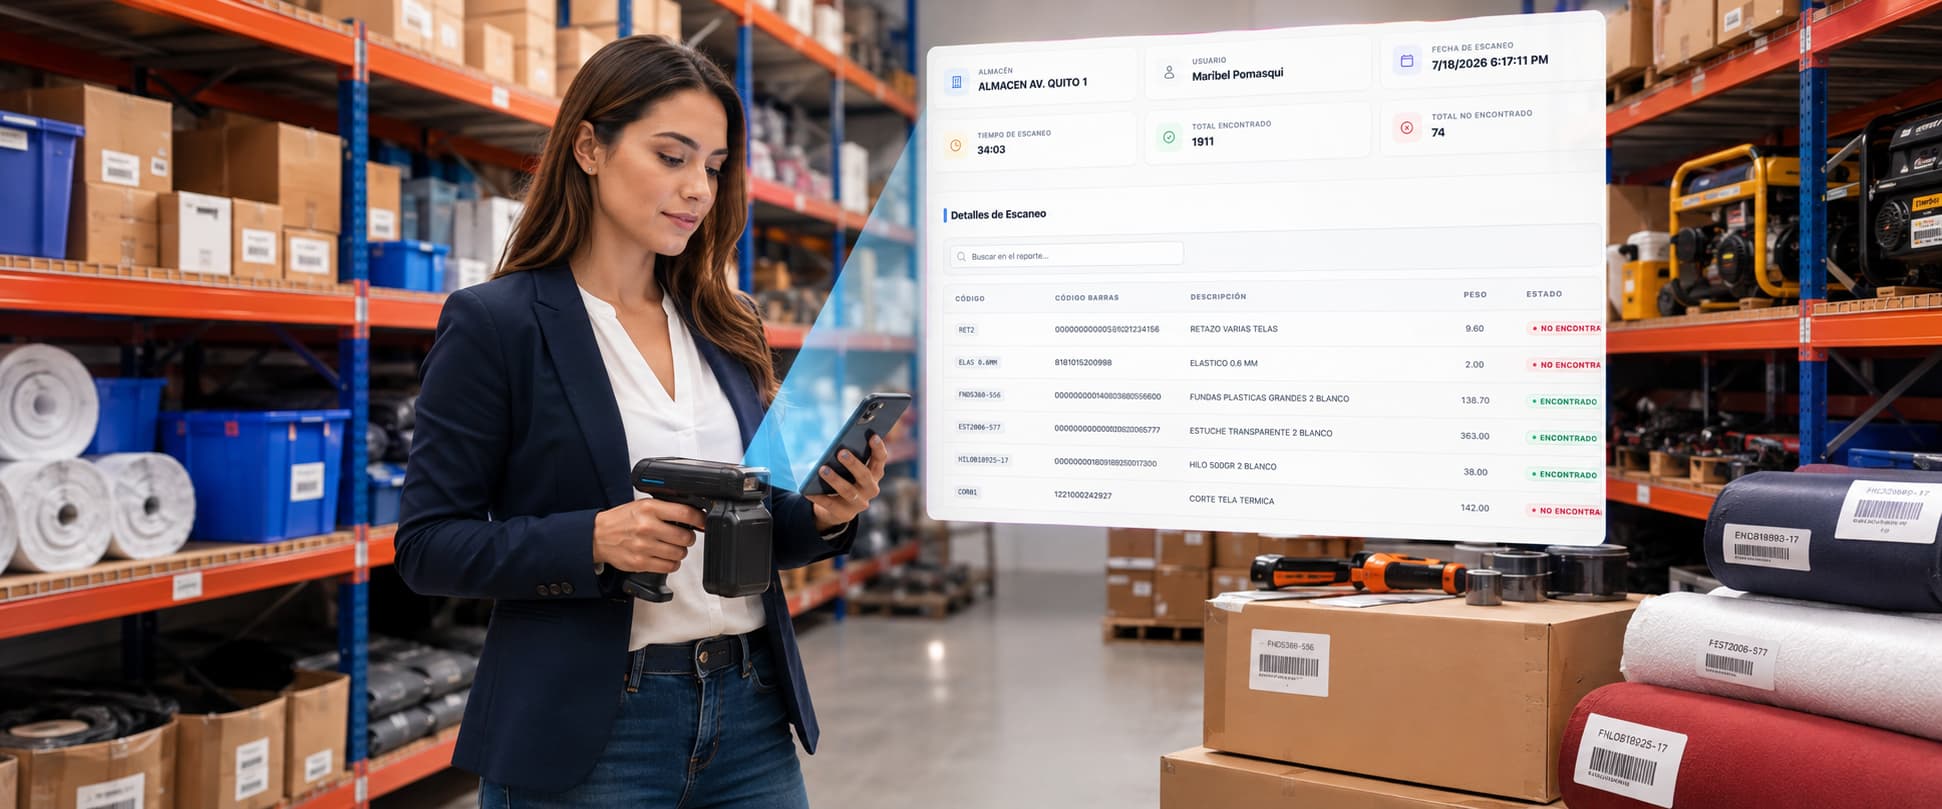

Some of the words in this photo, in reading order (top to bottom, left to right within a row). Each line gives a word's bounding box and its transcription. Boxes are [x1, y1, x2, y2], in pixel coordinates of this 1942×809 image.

[1431, 44, 1460, 54] FECHA
[1461, 43, 1473, 52] DE
[1474, 41, 1514, 51] ESCANEO
[1191, 56, 1227, 65] USUARIO
[1431, 57, 1488, 72] 7/18/2026
[1490, 55, 1528, 68] 6:17:11
[1530, 54, 1549, 65] PM
[978, 66, 1014, 76] ALMACÉN
[1192, 69, 1231, 82] Maribel
[1232, 66, 1284, 80] Pomasqui
[978, 79, 1028, 92] ALMACEN
[1029, 79, 1046, 89] AV.
[1047, 77, 1081, 89] QUITO
[1082, 77, 1088, 87] 1
[1431, 112, 1458, 121] TOTAL
[1459, 111, 1473, 120] NO
[1474, 109, 1533, 120] ENCONTRADO
[1191, 122, 1216, 131] TOTAL
[1217, 119, 1272, 130] ENCONTRADO
[977, 131, 1005, 139] TIEMPO
[1005, 130, 1016, 139] DE
[1017, 129, 1052, 138] ESCANEO
[1431, 127, 1446, 138] 74
[1191, 136, 1214, 147] 1911
[977, 144, 1006, 155] 34:03
[950, 209, 990, 220] Detalles
[991, 209, 1004, 220] de
[1005, 209, 1047, 219] Escaneo
[971, 252, 997, 261] Buscar
[997, 253, 1007, 261] en
[1007, 251, 1016, 261] el
[1016, 252, 1049, 262] reporte...
[954, 293, 985, 303] CÓDIGO
[1054, 293, 1086, 302] CÓDIGO
[1087, 293, 1120, 302] BARRAS
[1190, 291, 1247, 301] DESCRIPCIÓN
[1463, 290, 1488, 299] PESO
[1526, 290, 1563, 298] ESTADO
[958, 326, 975, 334] RET2
[1189, 324, 1222, 334] RETAZO
[1222, 324, 1252, 334] VARIAS
[1252, 324, 1279, 333] TELAS
[1465, 324, 1485, 333] 9.60
[1540, 324, 1554, 332] NO
[958, 358, 975, 366] ELAS
[1189, 359, 1229, 368] ELASTICO
[1229, 359, 1243, 368] 0.6
[1243, 359, 1259, 367] MM
[1464, 360, 1485, 369] 2.00
[1540, 361, 1554, 369] NO
[1189, 392, 1222, 402] FUNDAS
[1223, 393, 1267, 402] PLASTICAS
[1268, 393, 1308, 403] GRANDES
[1308, 394, 1315, 403] 2
[1315, 394, 1350, 403] BLANCO
[1461, 396, 1491, 405] 138.70
[1539, 397, 1598, 406] ENCONTRADO
[1189, 426, 1227, 436] ESTUCHE
[1228, 427, 1291, 437] TRANSPARENTE
[1292, 428, 1298, 437] 2
[1298, 428, 1333, 438] BLANCO
[1460, 431, 1490, 441] 363.00
[1539, 434, 1598, 443] ENCONTRADO
[1189, 460, 1208, 470] HILO
[1209, 461, 1236, 470] 500GR
[1236, 461, 1243, 471] 2
[1243, 462, 1278, 471] BLANCO
[1463, 467, 1489, 477] 38.00
[1539, 470, 1598, 480] ENCONTRADO
[1188, 494, 1216, 504] CORTE
[1217, 495, 1238, 504] TELA
[1239, 496, 1275, 506] TERMICA
[1460, 503, 1490, 513] 142.00
[1539, 507, 1553, 515] NO
